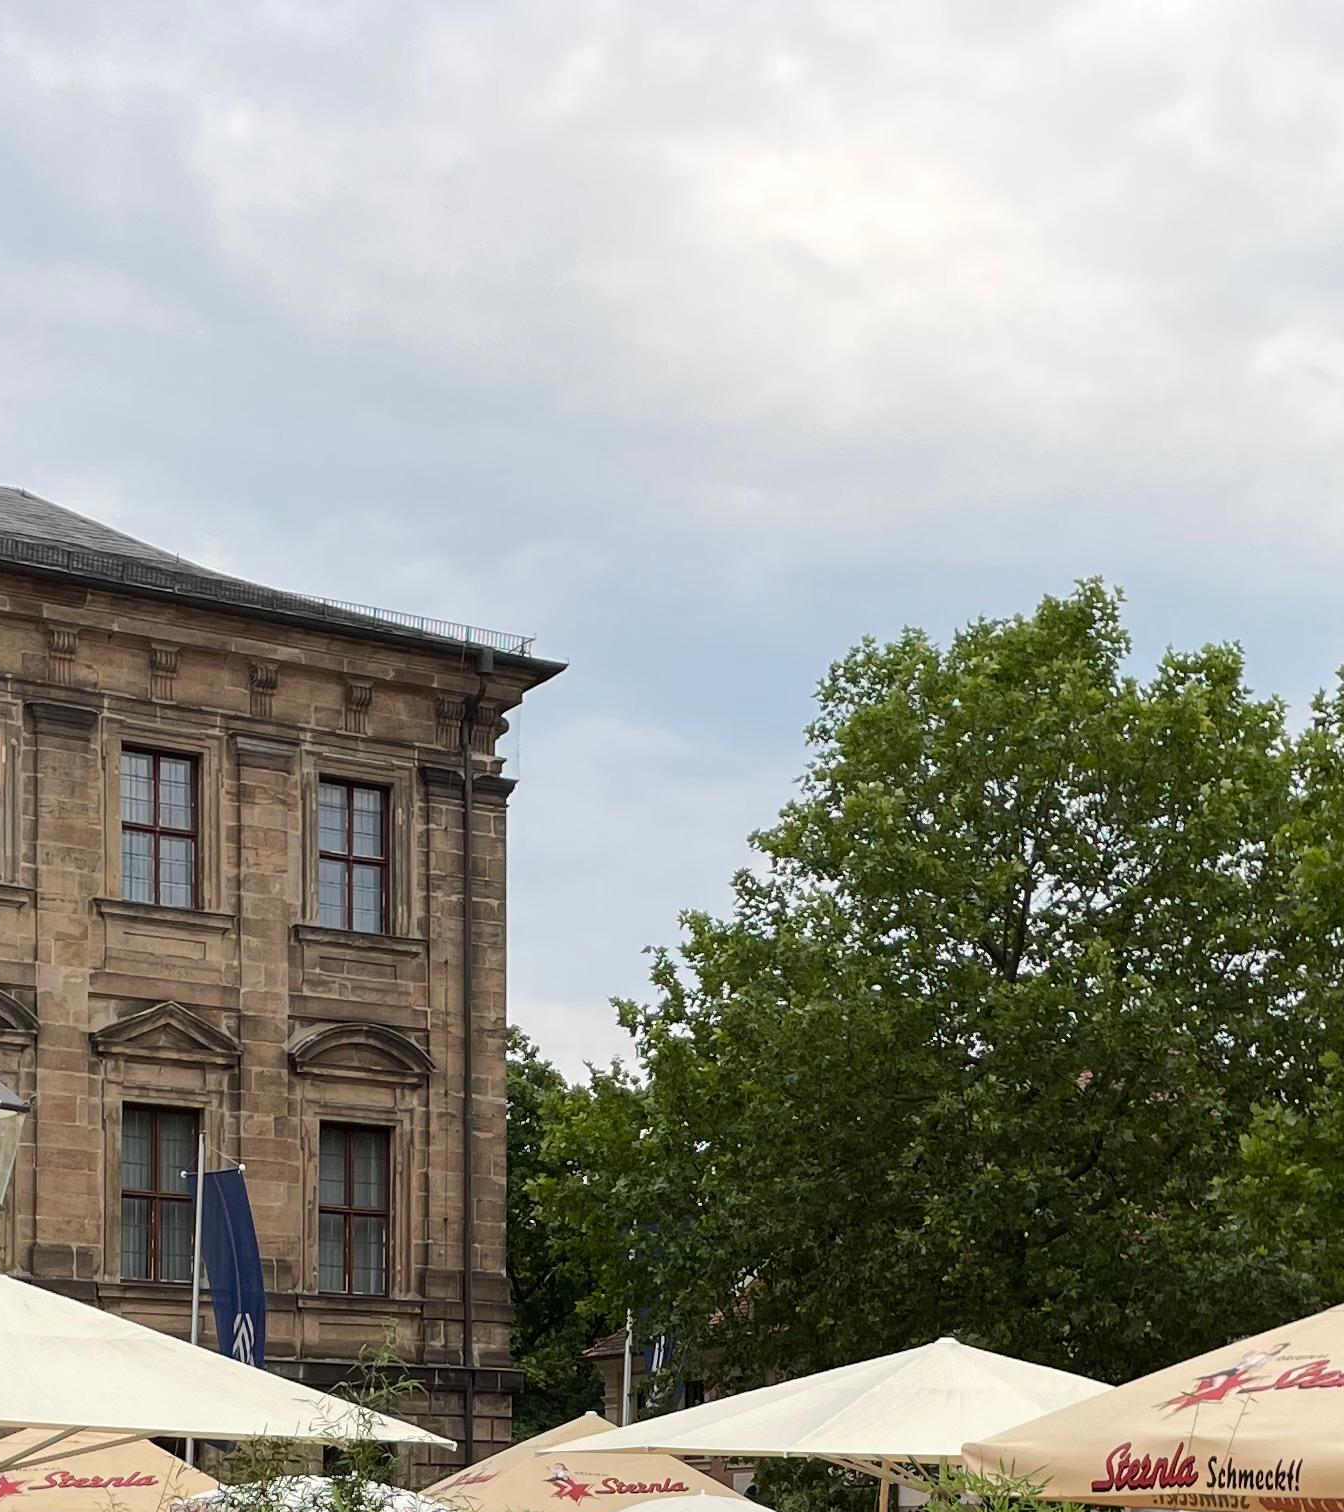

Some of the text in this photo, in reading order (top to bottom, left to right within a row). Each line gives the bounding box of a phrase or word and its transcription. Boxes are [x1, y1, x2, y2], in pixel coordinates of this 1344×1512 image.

[1091, 1441, 1303, 1492] Sternla Schmeckt!
[28, 1471, 159, 1491] Sternla
[595, 1477, 690, 1495] Sternla
